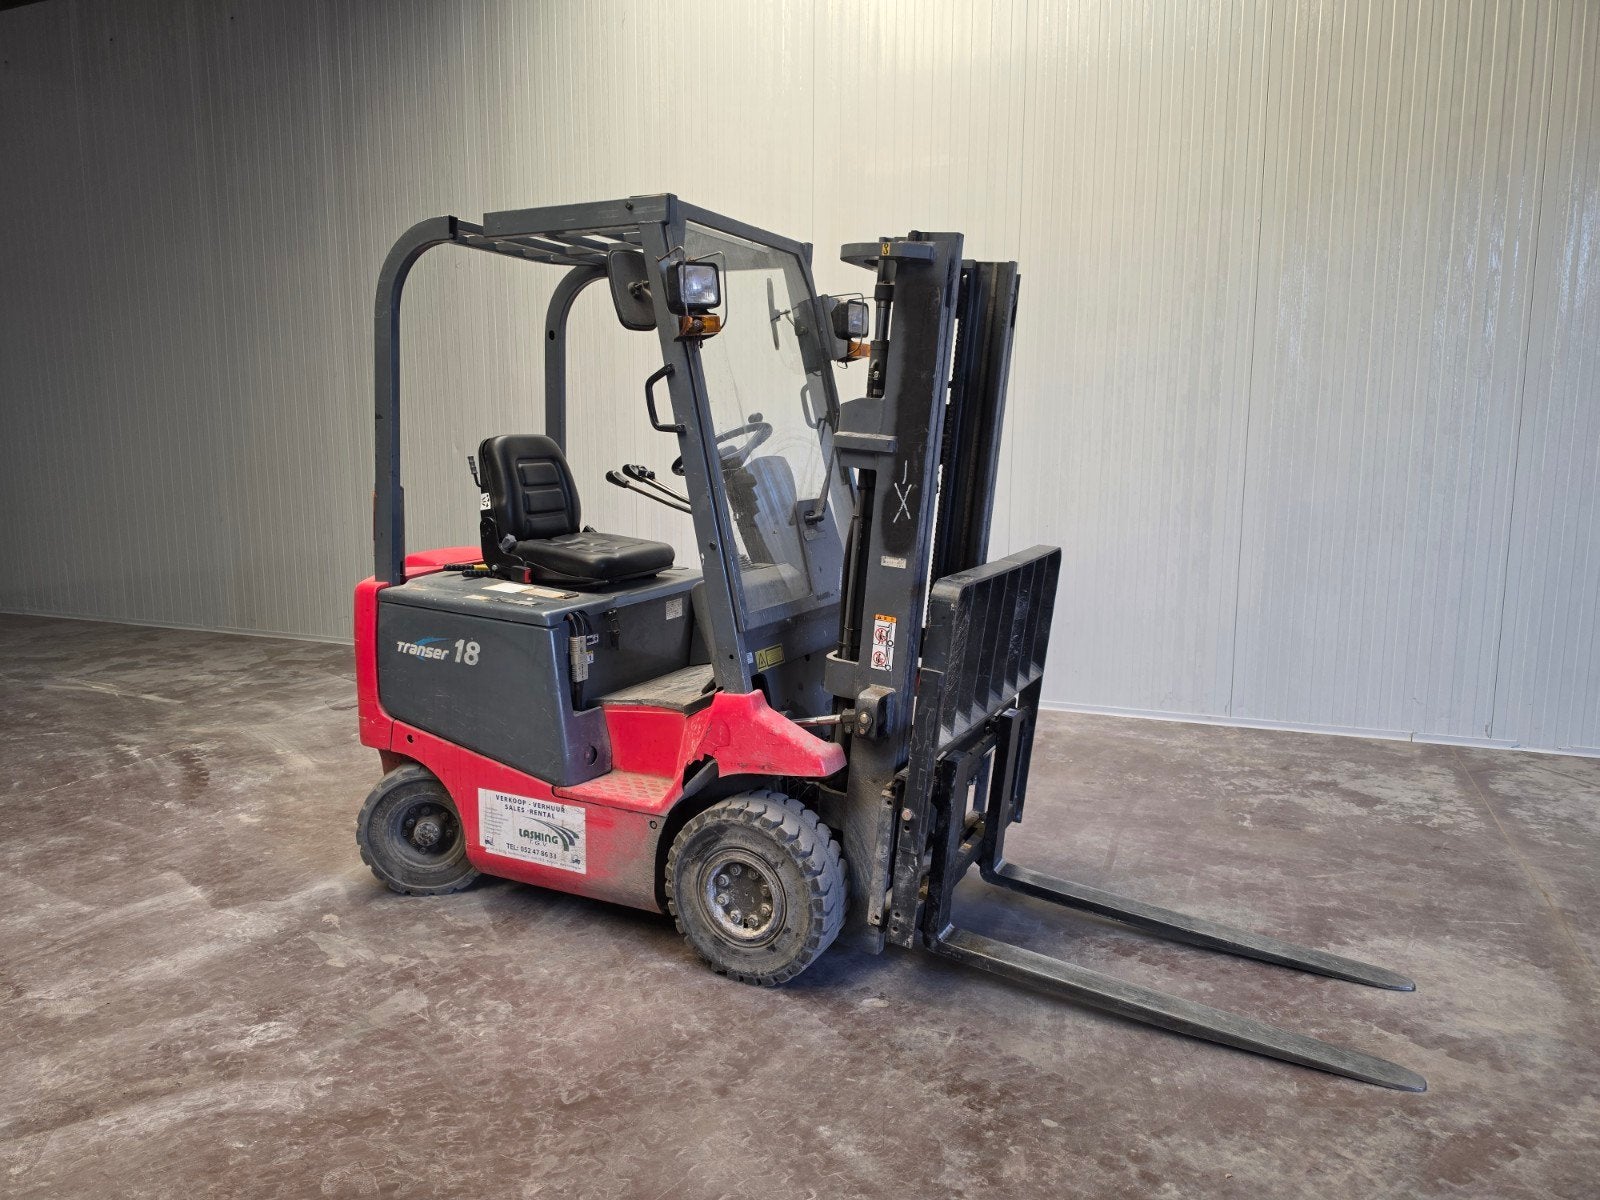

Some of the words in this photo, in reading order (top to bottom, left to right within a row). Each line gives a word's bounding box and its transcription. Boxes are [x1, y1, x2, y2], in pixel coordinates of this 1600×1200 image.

[396, 641, 449, 660] Transer
[455, 639, 480, 665] 18
[496, 794, 526, 805] VERKOOP
[533, 802, 565, 813] VERHUUR
[505, 804, 524, 813] SALES
[529, 809, 555, 819] RENTAL
[519, 829, 559, 844] LASHING
[506, 843, 518, 851] TEL:
